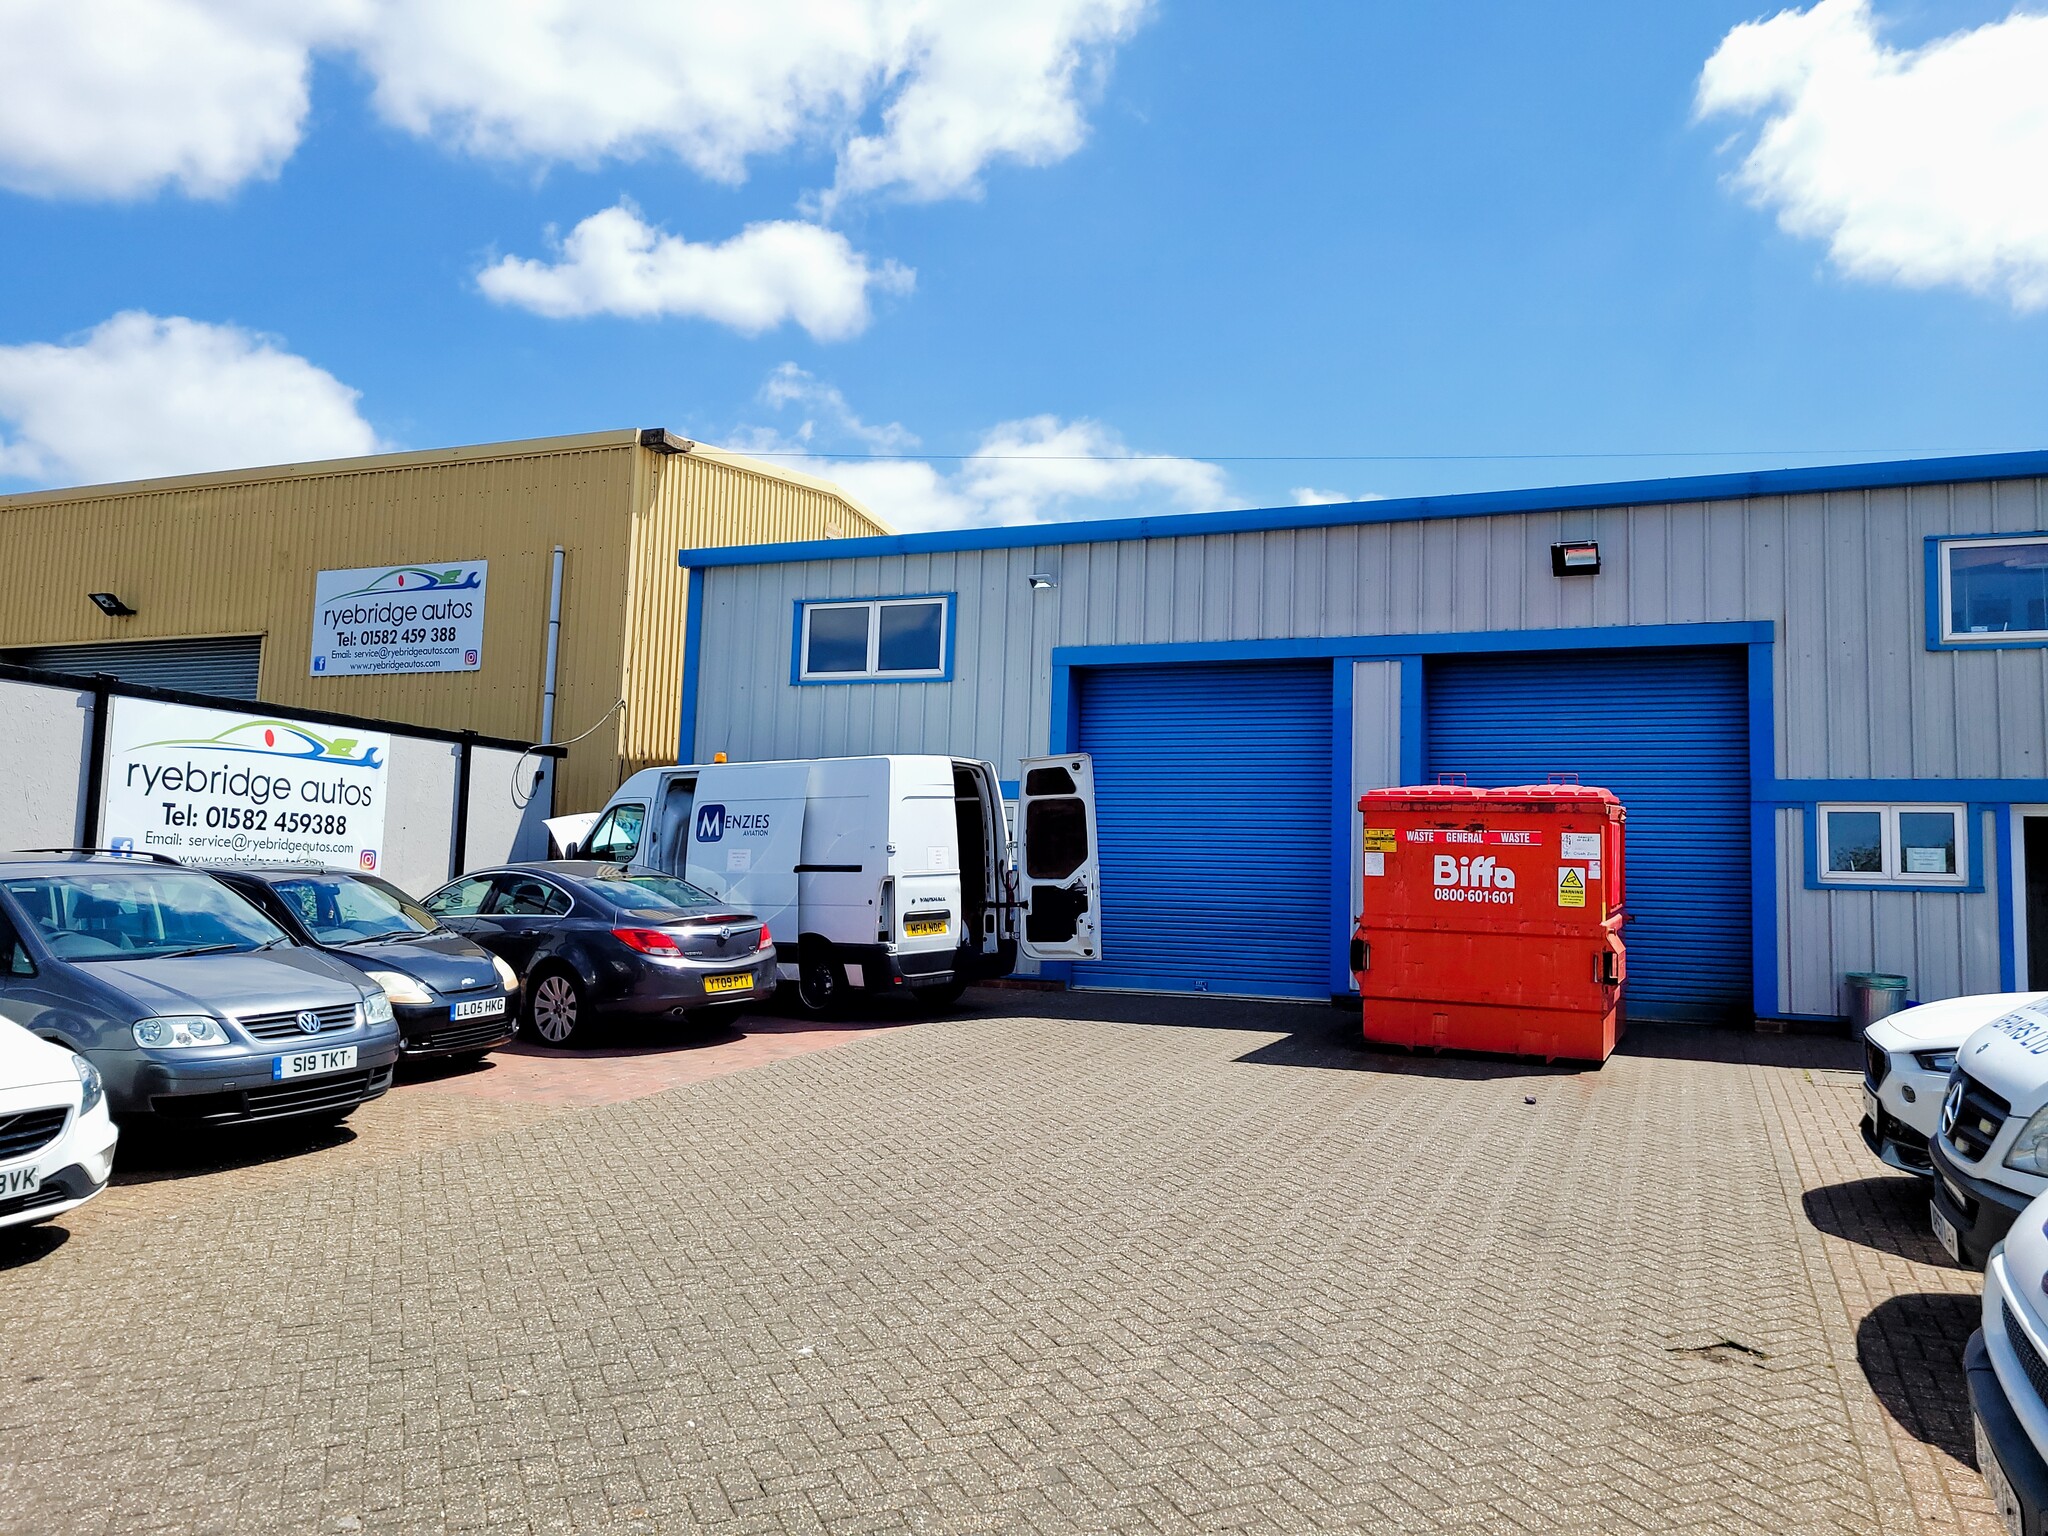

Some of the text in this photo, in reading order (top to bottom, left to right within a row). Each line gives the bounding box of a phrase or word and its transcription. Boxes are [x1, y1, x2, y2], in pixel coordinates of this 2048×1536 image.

[324, 599, 473, 630] ryebridge autos
[337, 627, 456, 647] Tel: 01582 459 388
[331, 646, 460, 660] Email: service@ryebridgeautos.com
[350, 660, 441, 672] www.ryebridgeautos.com
[127, 761, 372, 806] ryebridge autos
[162, 803, 347, 835] Tel: 01582 459388
[699, 811, 770, 837] MENZIES
[145, 830, 354, 854] Email: service@ryebridgeautos.com
[1406, 831, 1435, 842] WASTE
[1446, 832, 1484, 843] GENERAL
[1501, 832, 1530, 843] WASTE
[1433, 855, 1516, 889] Biffa
[708, 975, 749, 990] YT09 PTY
[457, 999, 504, 1017] LL05 HKG
[293, 1050, 348, 1073] S19 TKT
